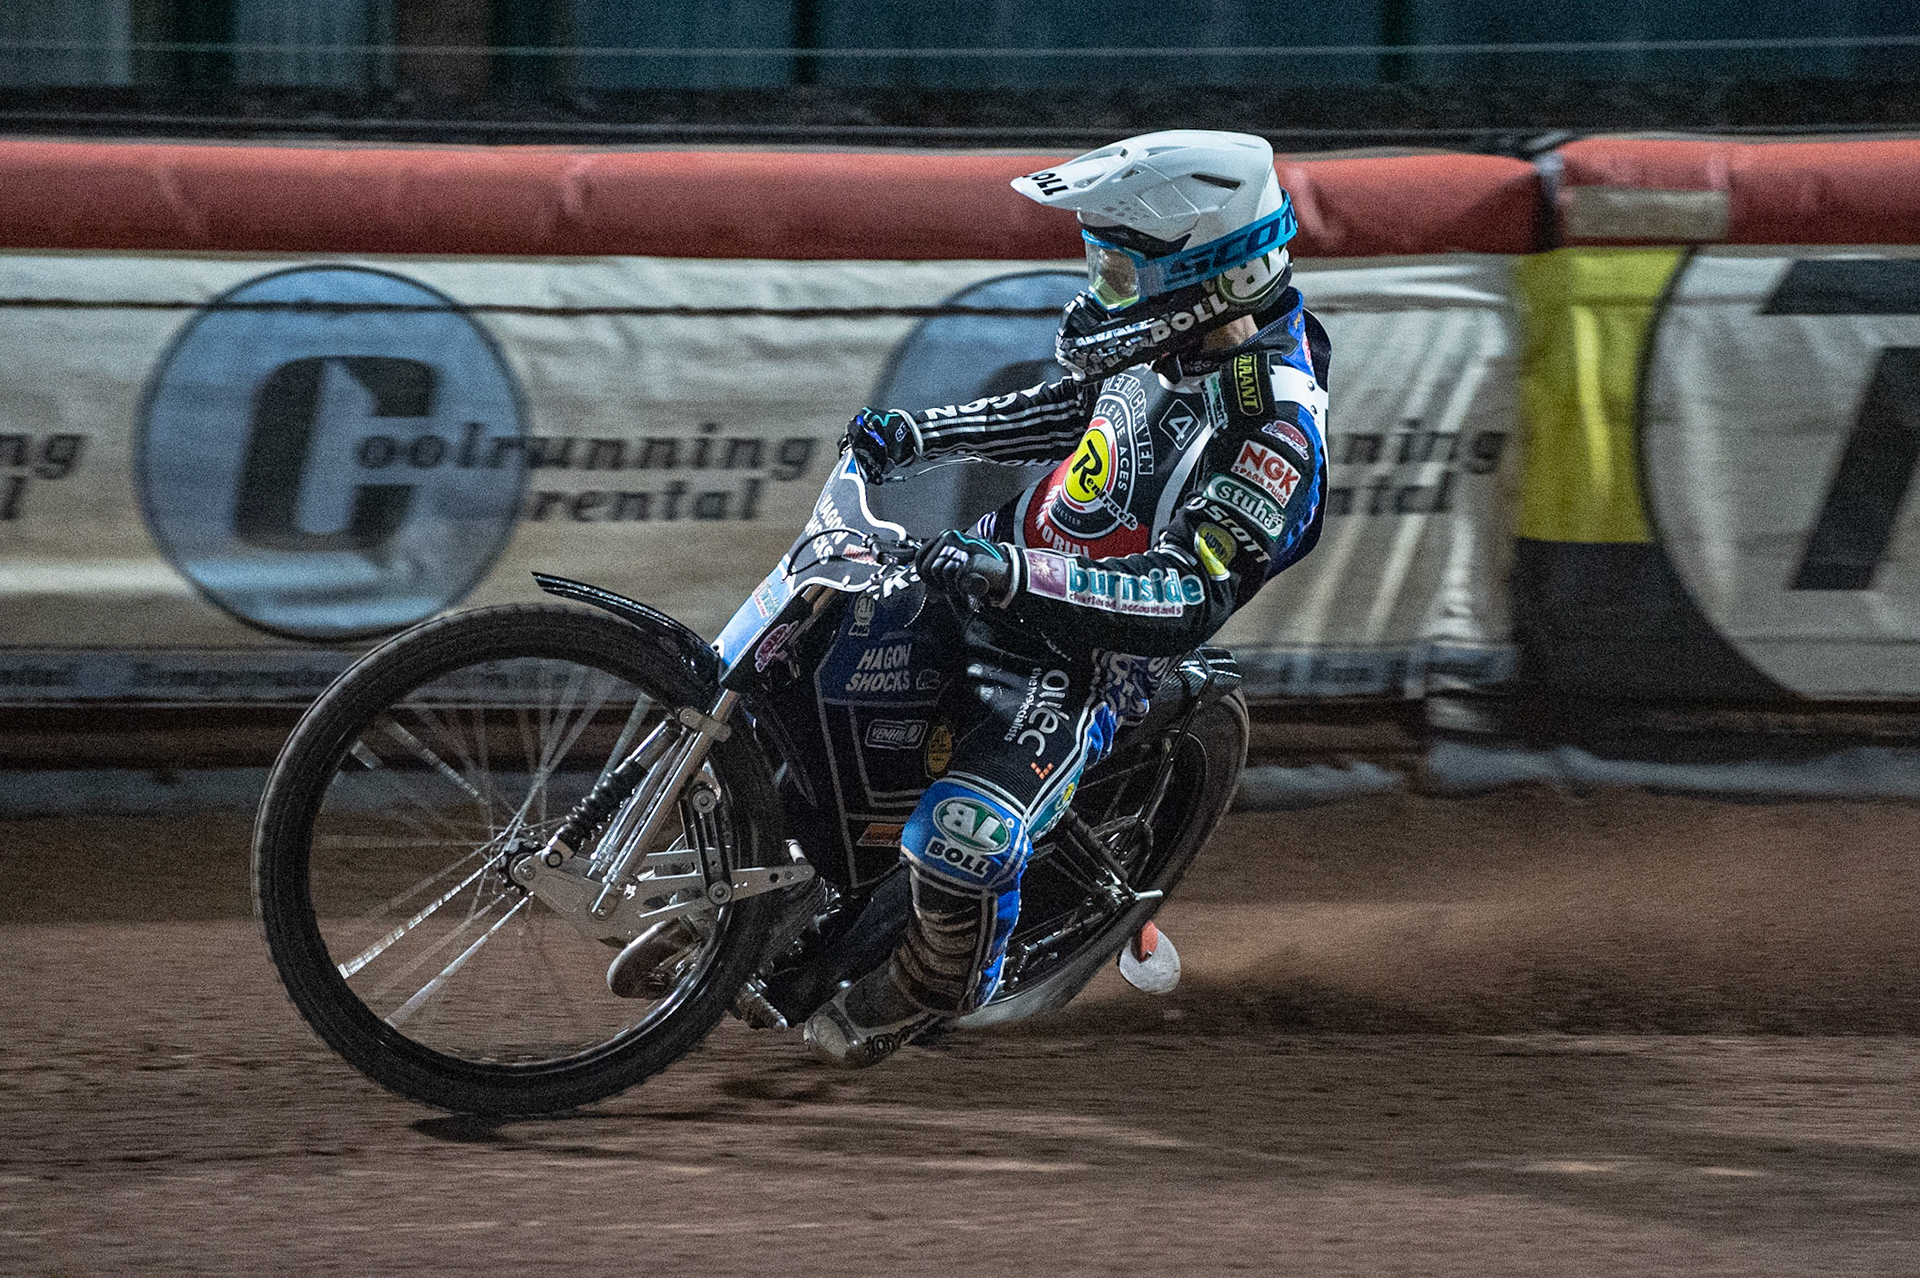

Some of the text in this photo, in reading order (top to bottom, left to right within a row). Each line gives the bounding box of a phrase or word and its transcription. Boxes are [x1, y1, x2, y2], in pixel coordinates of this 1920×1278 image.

[1023, 172, 1069, 197] OLL
[1164, 201, 1297, 286] SCOT
[1151, 293, 1229, 343] BOLL
[1112, 406, 1126, 439] VUE
[1130, 389, 1154, 475] CRAVEN
[1071, 439, 1138, 529] Rentruck
[1117, 446, 1130, 492] ACES
[1233, 465, 1288, 505] SPARK PLUGS
[1239, 443, 1299, 496] NGK
[526, 478, 764, 522] rental
[805, 515, 834, 565] HOCKS
[1203, 504, 1271, 563] SCOTT
[1068, 559, 1204, 604] burnside
[856, 643, 912, 670] HAGON
[845, 669, 911, 692] SHOCKS
[929, 839, 988, 876] BOLL
